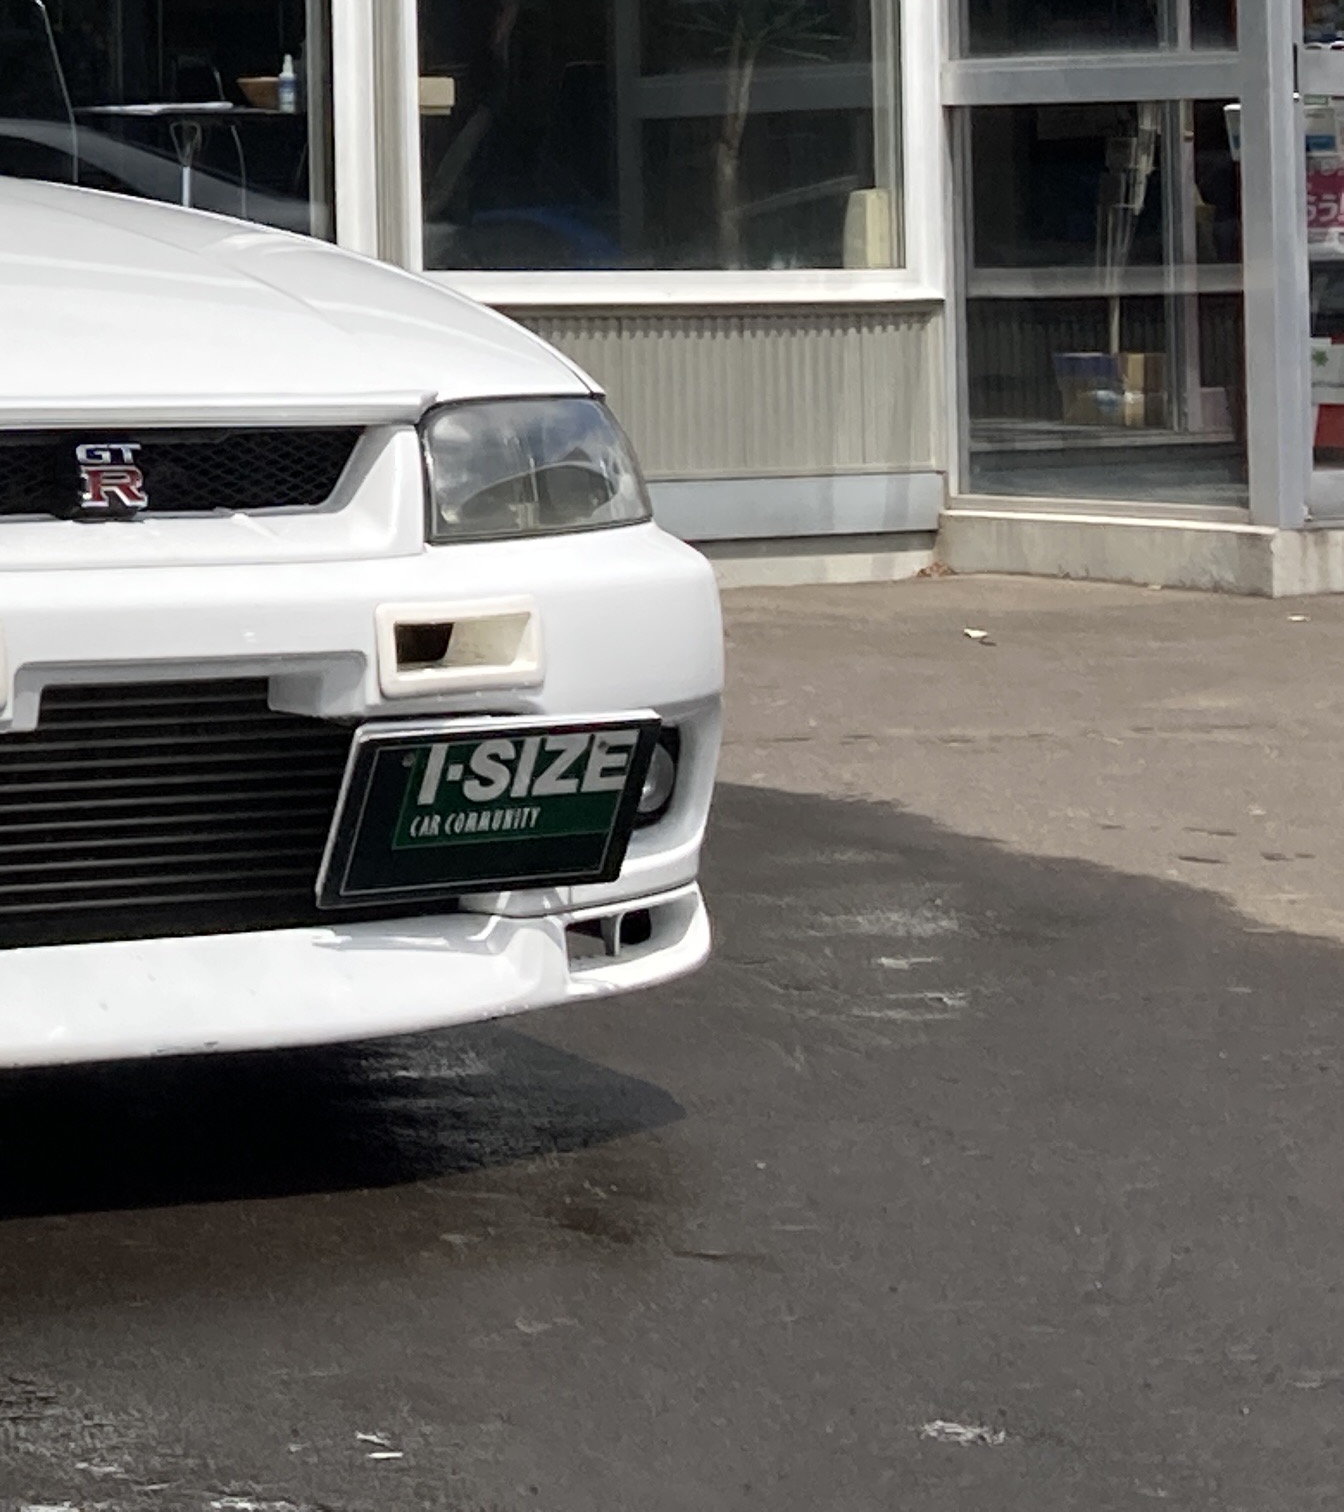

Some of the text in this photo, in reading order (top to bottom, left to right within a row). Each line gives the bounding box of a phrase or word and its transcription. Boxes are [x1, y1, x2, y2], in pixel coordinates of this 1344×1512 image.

[76, 443, 142, 464] GT
[79, 465, 148, 510] R
[409, 806, 541, 838] CAR COMMUNITY
